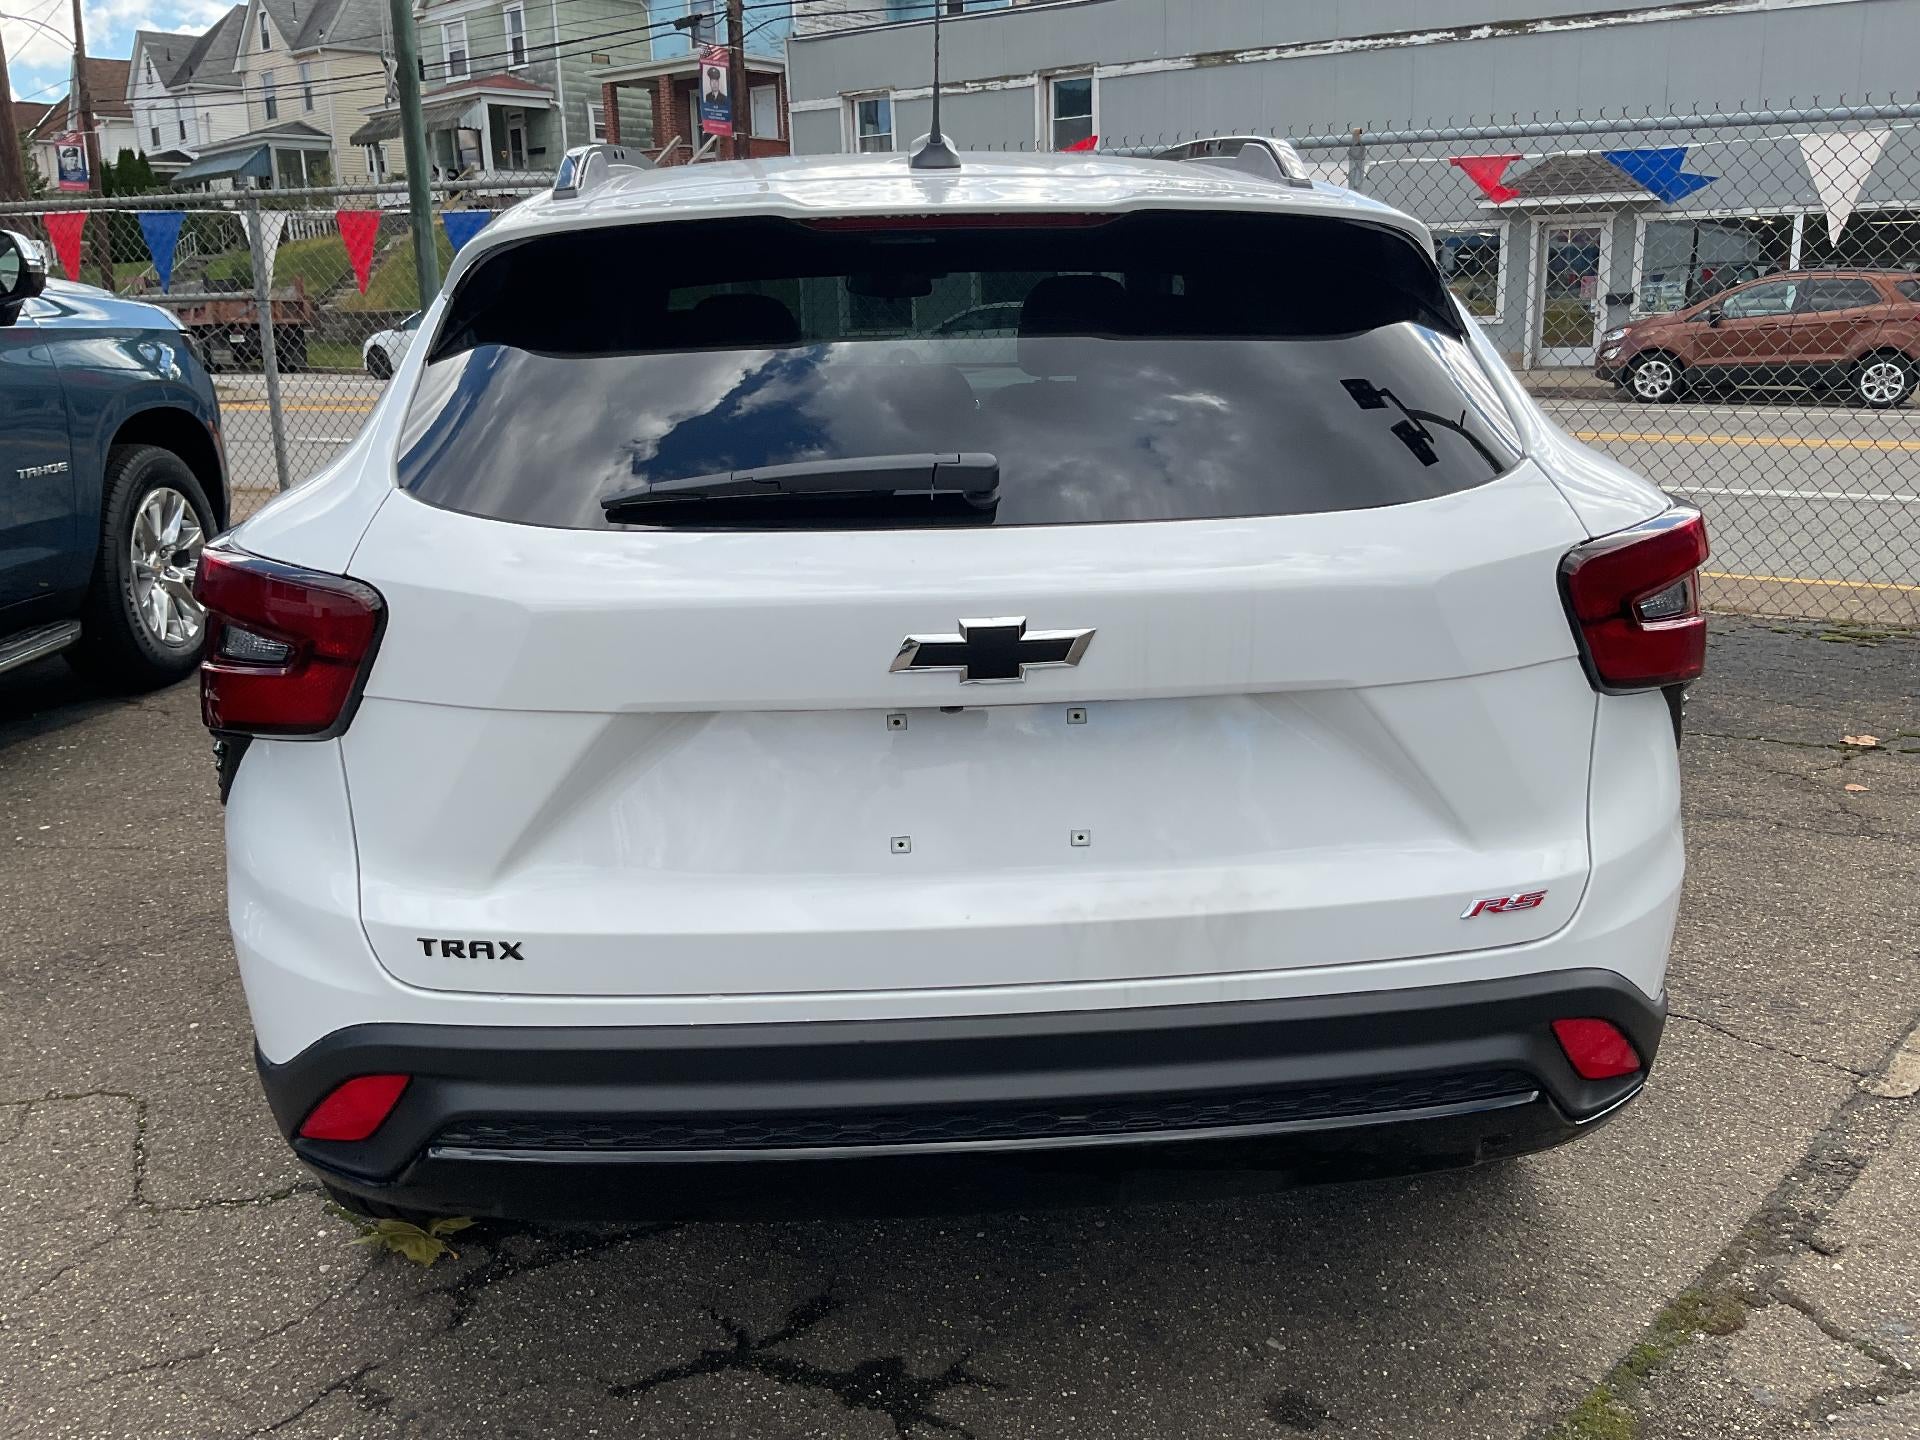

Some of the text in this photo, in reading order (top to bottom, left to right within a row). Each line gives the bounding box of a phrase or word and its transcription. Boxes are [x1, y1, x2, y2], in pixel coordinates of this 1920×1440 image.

[16, 461, 68, 479] TAHOE
[1460, 889, 1548, 919] RS
[416, 937, 525, 960] TRAX
